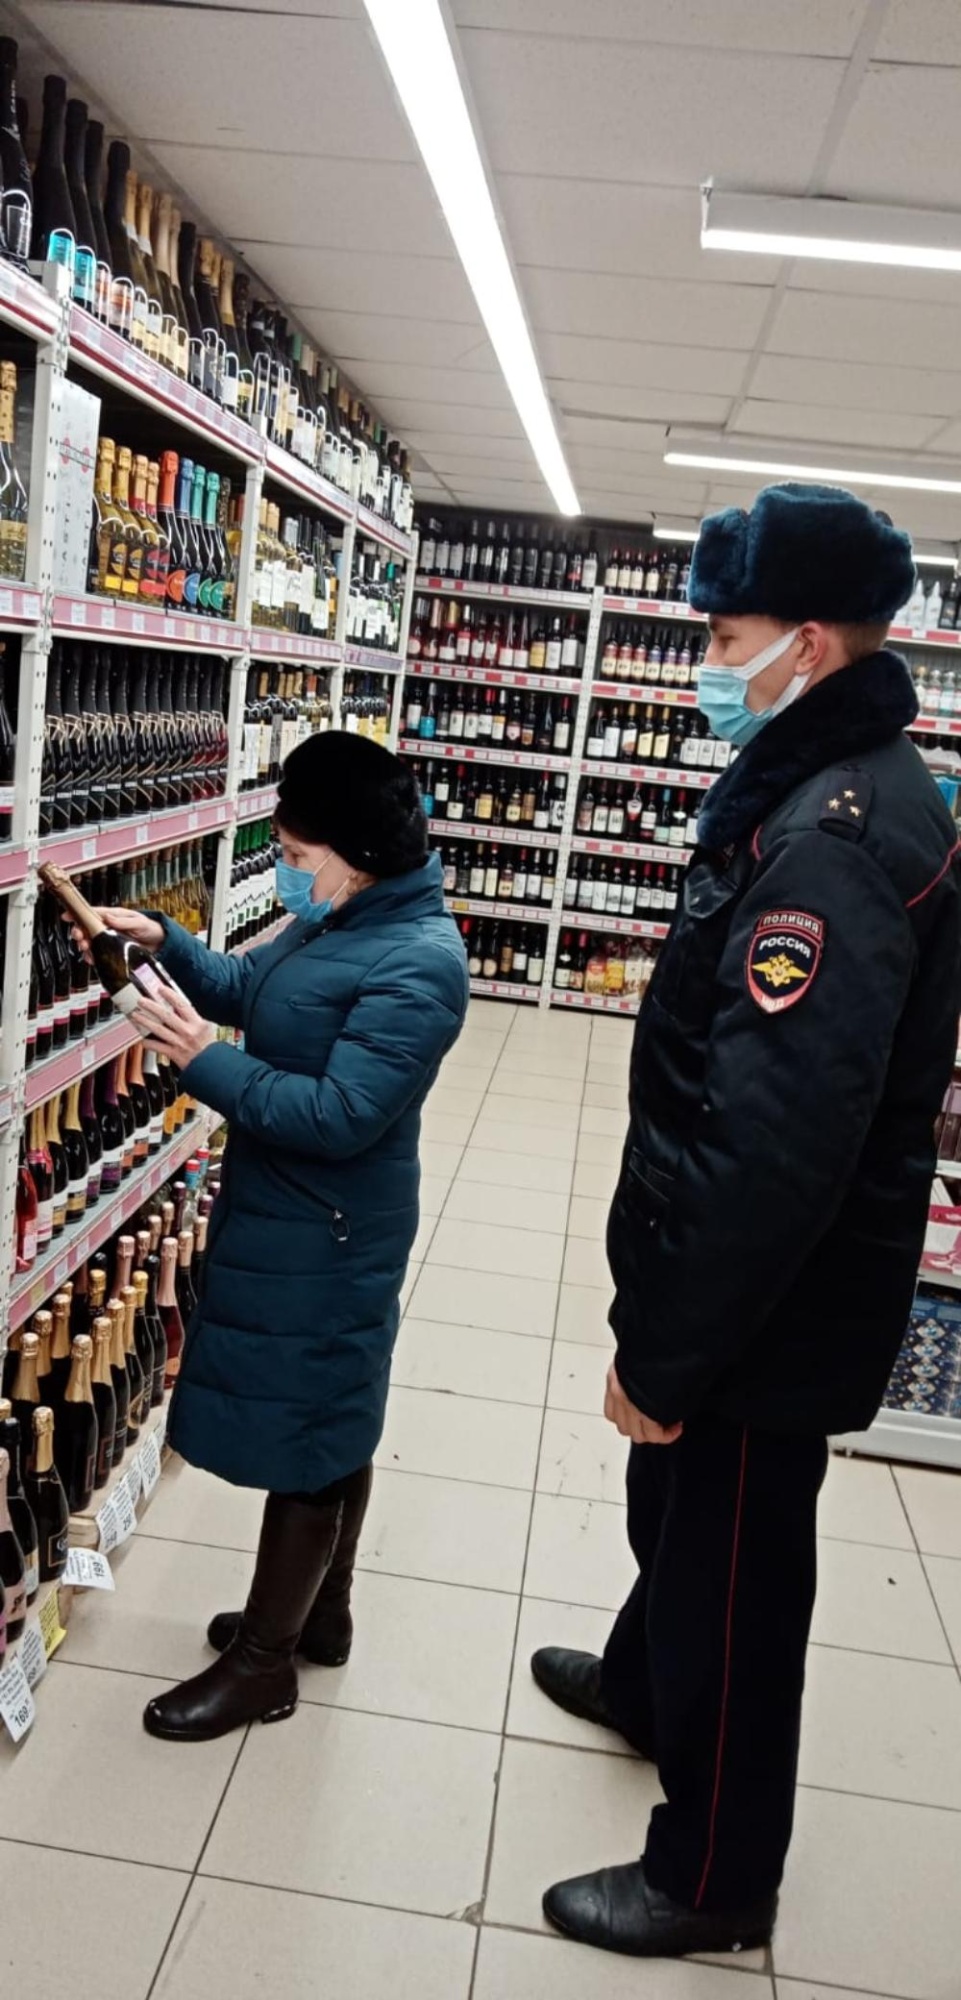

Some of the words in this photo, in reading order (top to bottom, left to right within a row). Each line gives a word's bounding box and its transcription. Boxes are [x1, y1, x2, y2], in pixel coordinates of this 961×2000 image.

[763, 914, 819, 933] ПОЛИЦИЯ
[759, 936, 811, 958] РОССИЯ
[15, 1705, 29, 1727] 169
